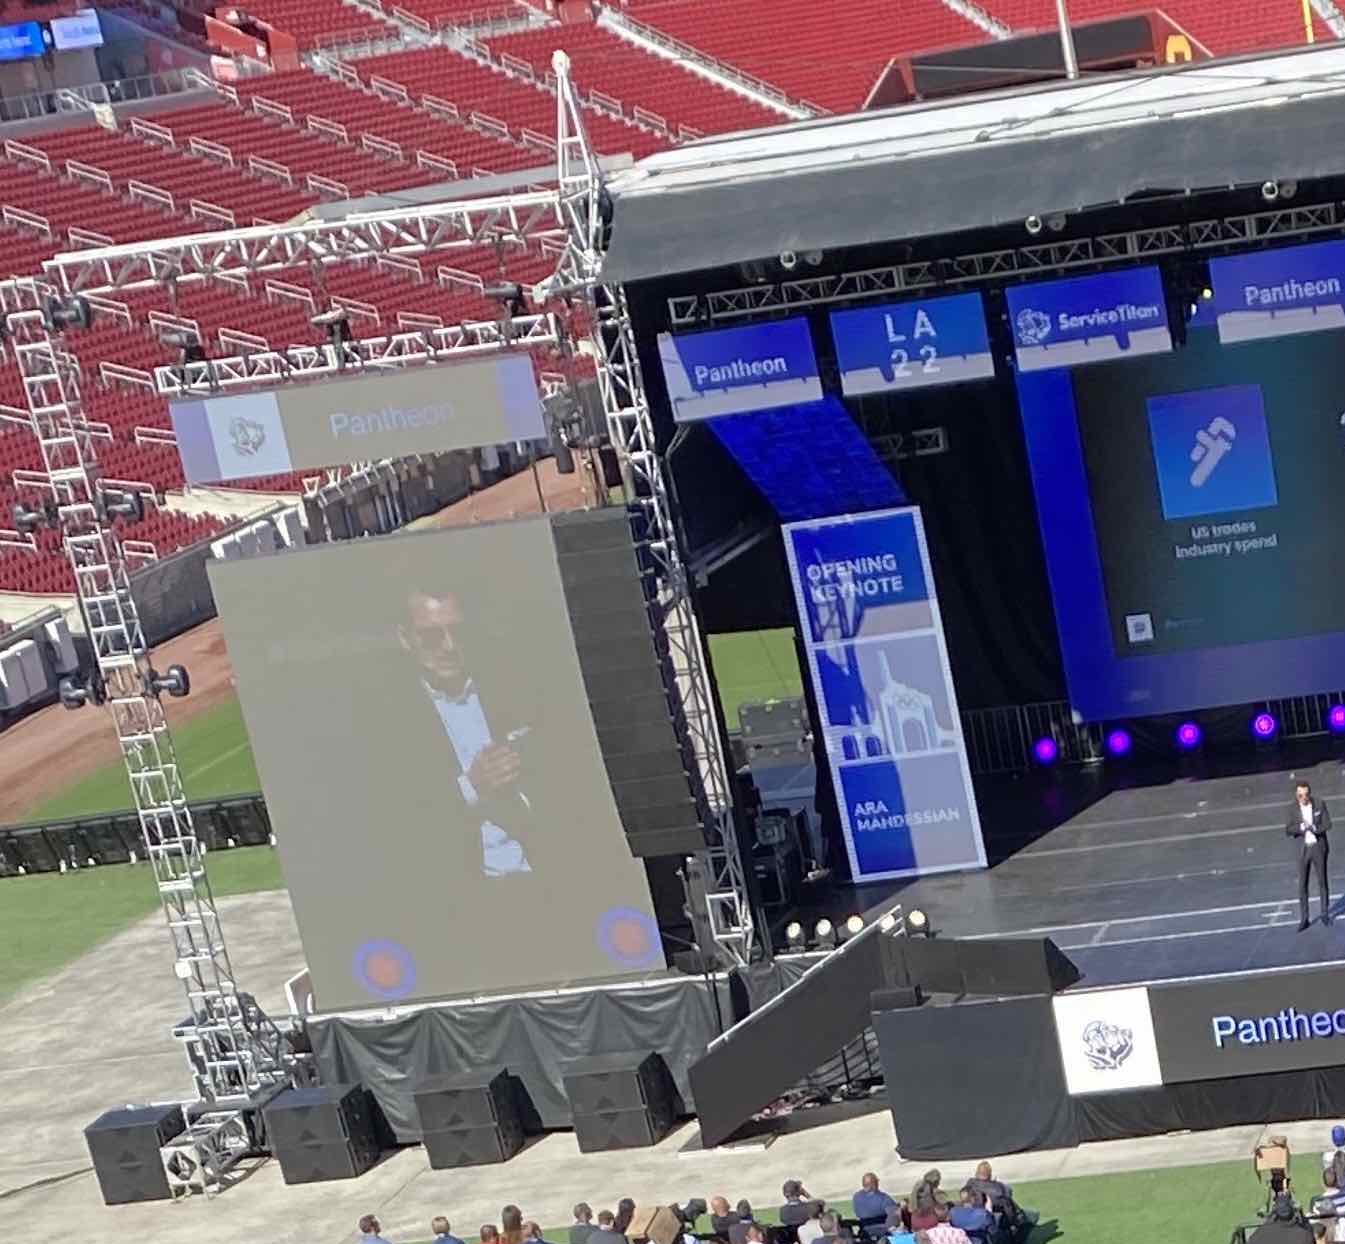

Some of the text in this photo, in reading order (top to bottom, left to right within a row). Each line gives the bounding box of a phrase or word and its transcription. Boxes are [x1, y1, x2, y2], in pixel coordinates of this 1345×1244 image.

[1243, 277, 1341, 306] Pantheon
[1057, 303, 1160, 331] ServiceTitan
[693, 356, 788, 386] Pantheon
[328, 404, 452, 439] Pantheon
[1190, 520, 1257, 539] US trades
[1234, 533, 1278, 554] spend
[806, 554, 898, 581] OPENING
[809, 575, 904, 603] KEYNOTE
[854, 800, 889, 817] ARA
[857, 807, 961, 832] MAHDESSIAN
